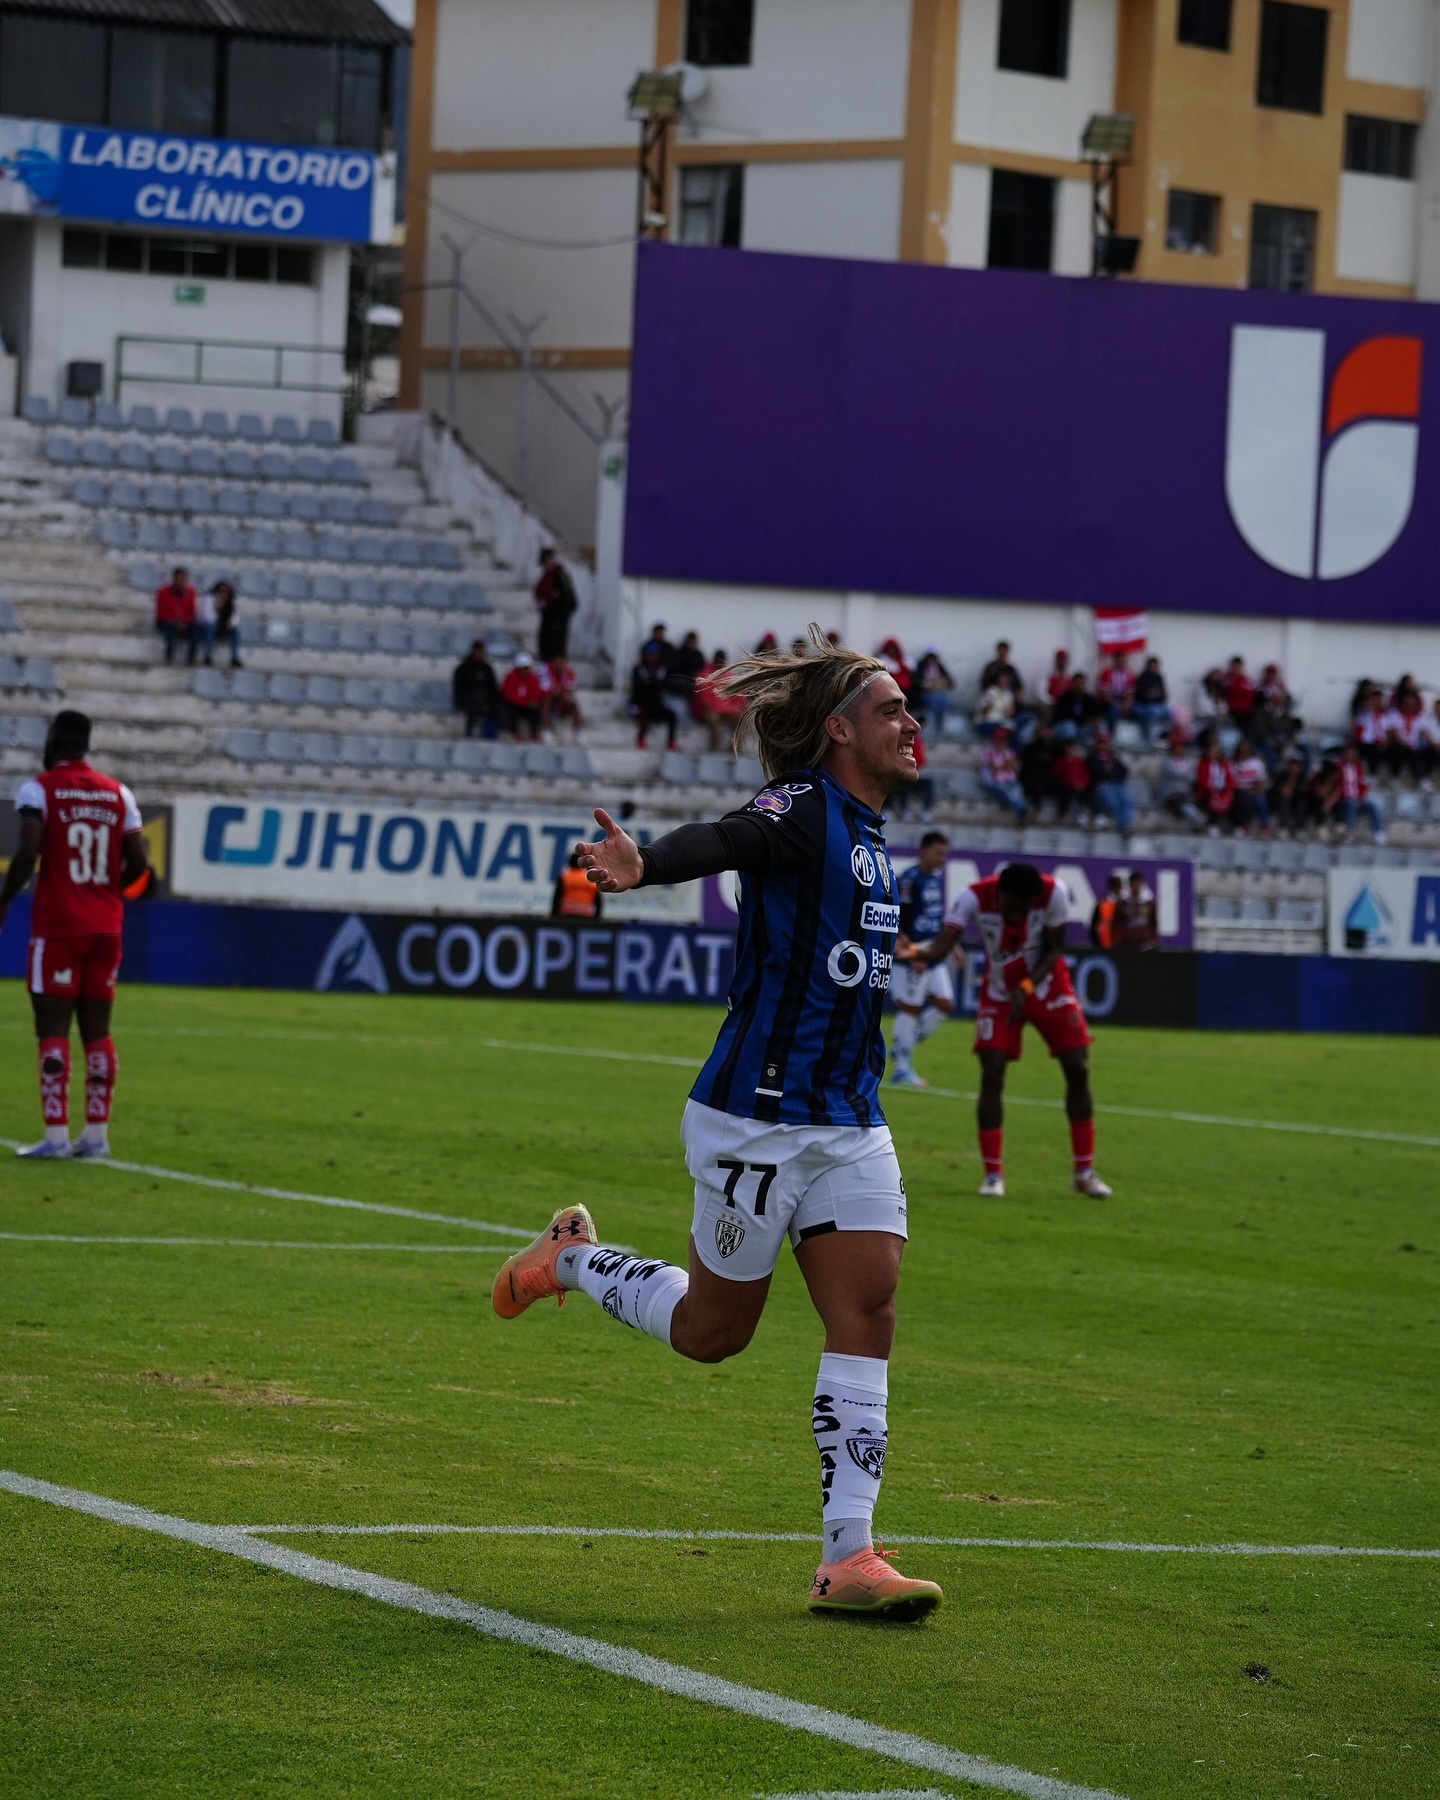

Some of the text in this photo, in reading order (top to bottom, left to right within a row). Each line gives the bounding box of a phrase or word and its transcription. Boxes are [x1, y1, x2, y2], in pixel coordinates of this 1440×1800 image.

[69, 132, 372, 190] LABORATORIO
[135, 183, 305, 230] CLÍNICO
[67, 822, 110, 886] 31
[286, 810, 653, 886] JHONAT
[400, 922, 732, 998] COOPERAT
[868, 969, 890, 991] Gua
[872, 948, 893, 969] Ban
[717, 1160, 777, 1216] 77
